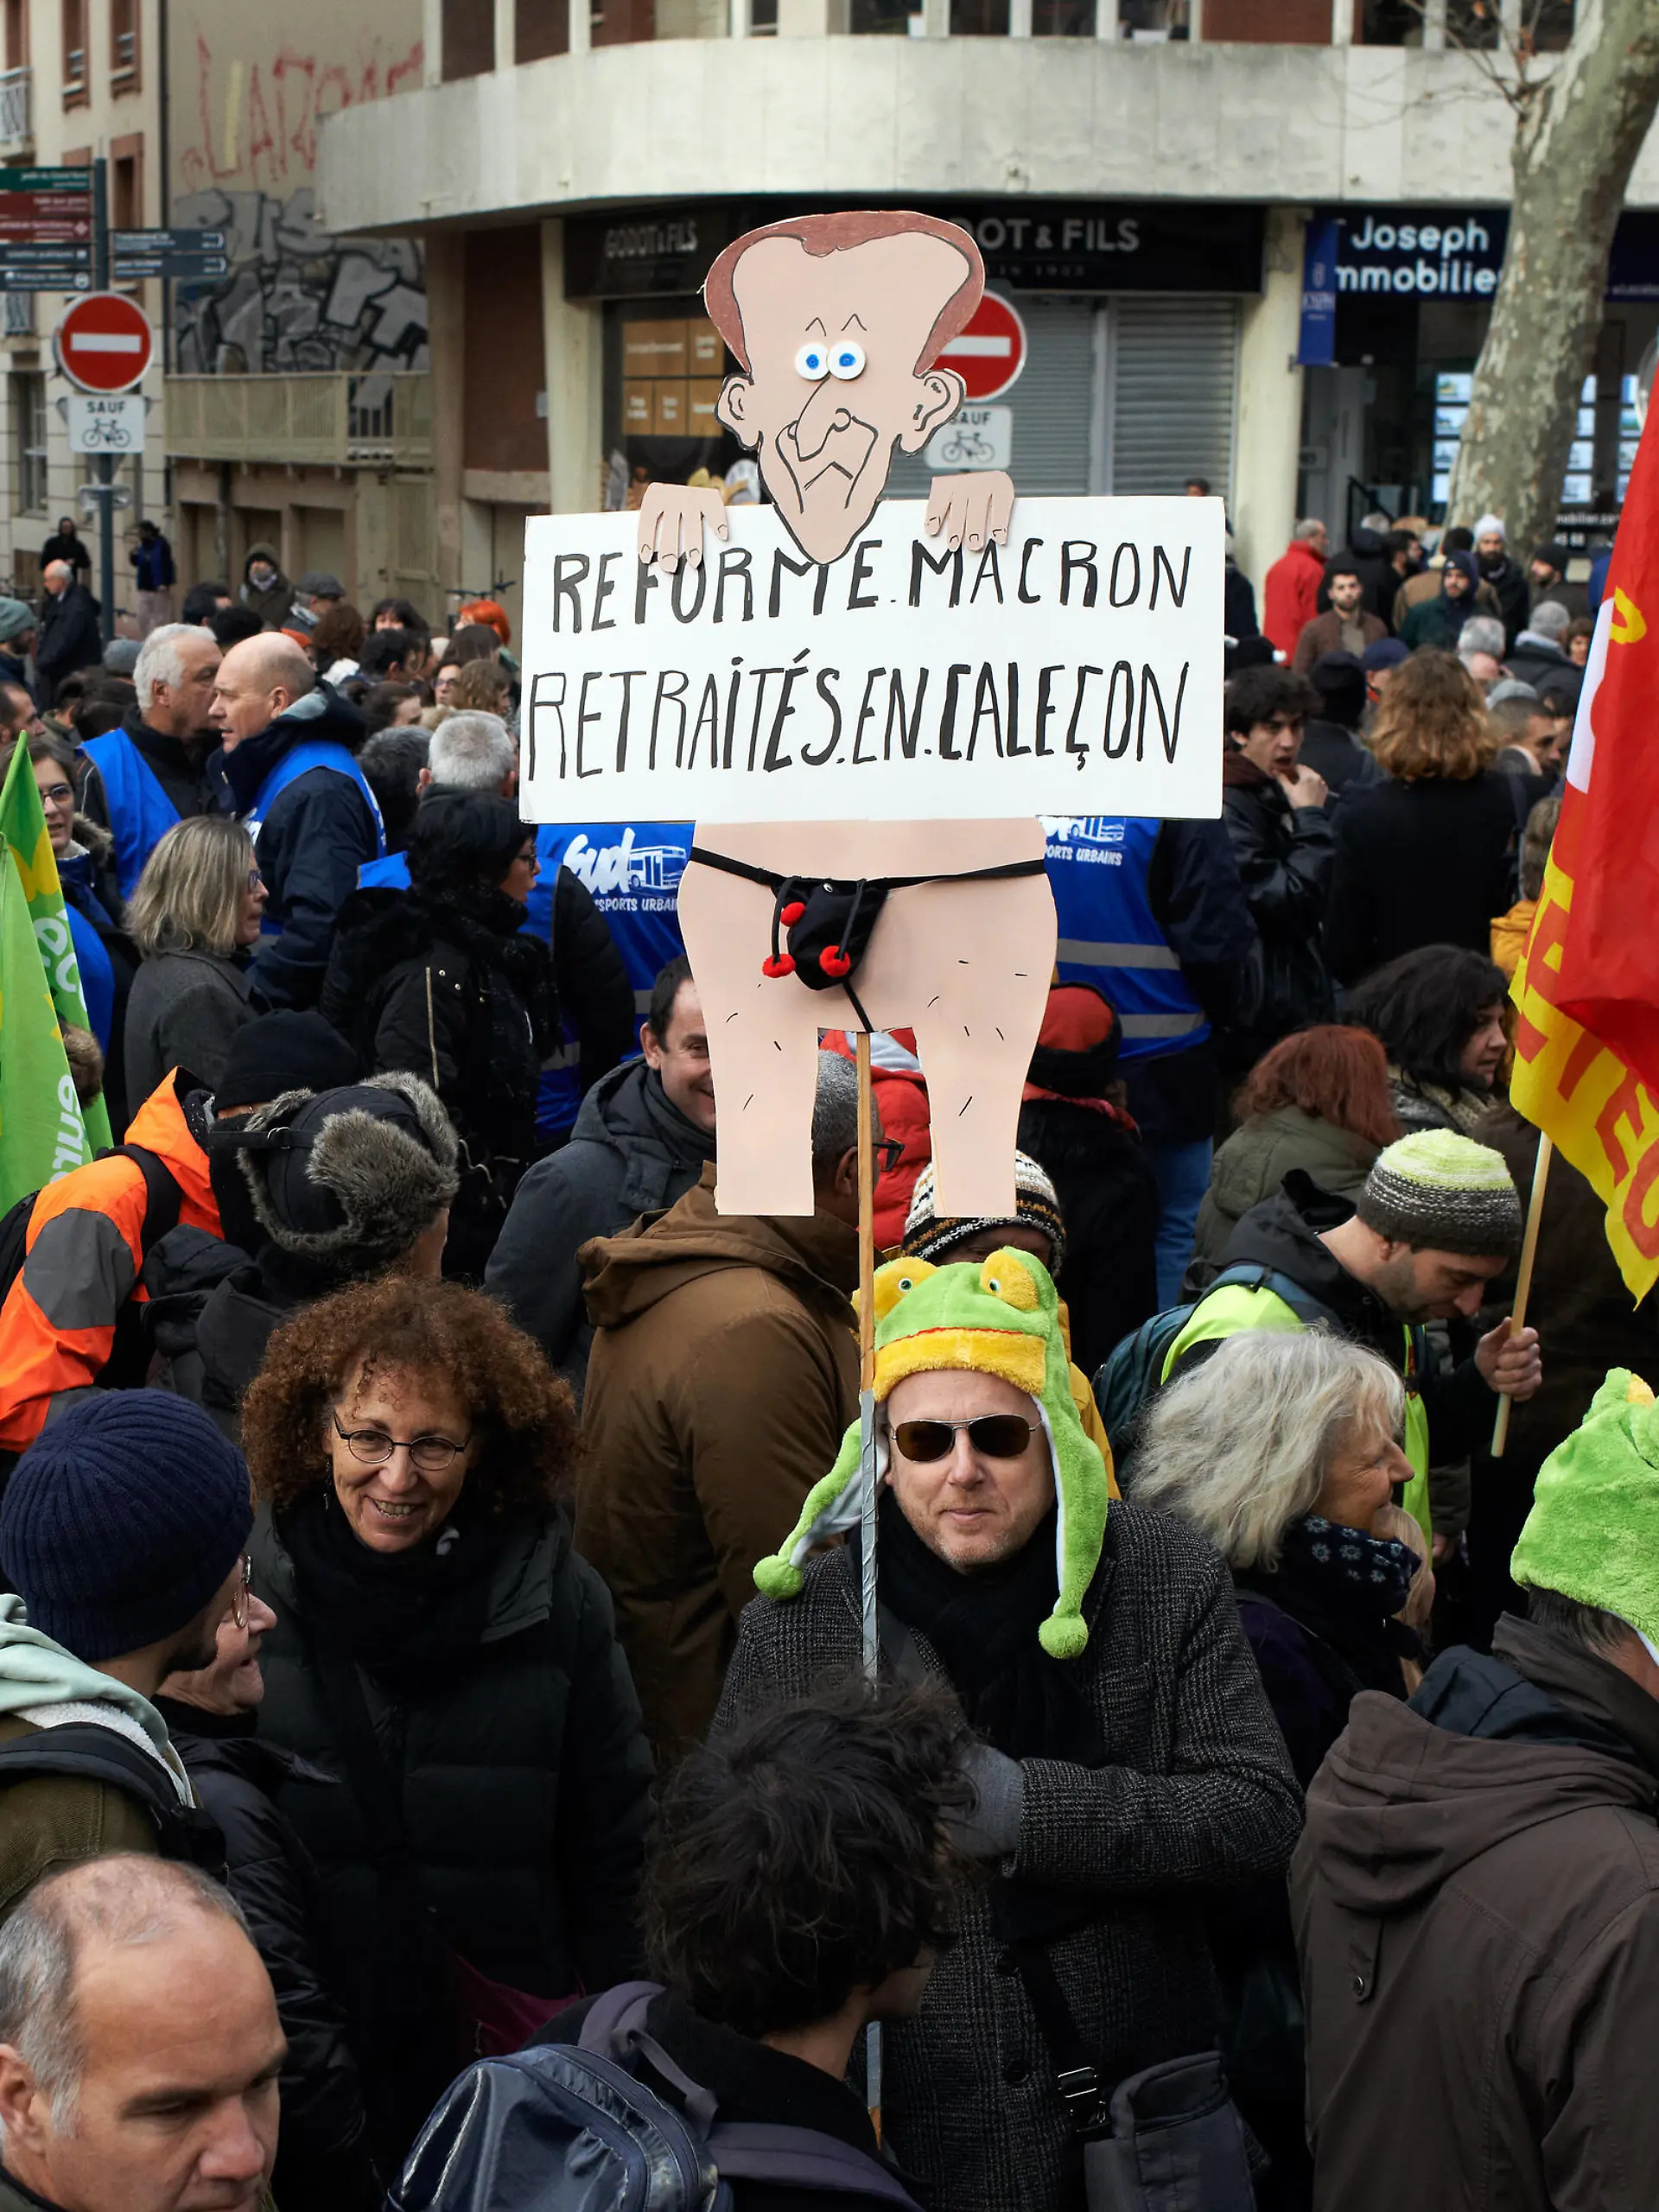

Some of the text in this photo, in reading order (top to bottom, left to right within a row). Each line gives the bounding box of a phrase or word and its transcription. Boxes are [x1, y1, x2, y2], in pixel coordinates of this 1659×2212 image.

[1035, 225, 1053, 249] &
[1062, 218, 1140, 251] FILS
[1351, 216, 1489, 259] Joseph
[1335, 259, 1503, 293] mmobilie
[87, 401, 124, 413] SAUF
[909, 538, 1192, 611] MACRON
[939, 660, 1189, 771] CALEÇON
[1076, 848, 1122, 866] URBAINS
